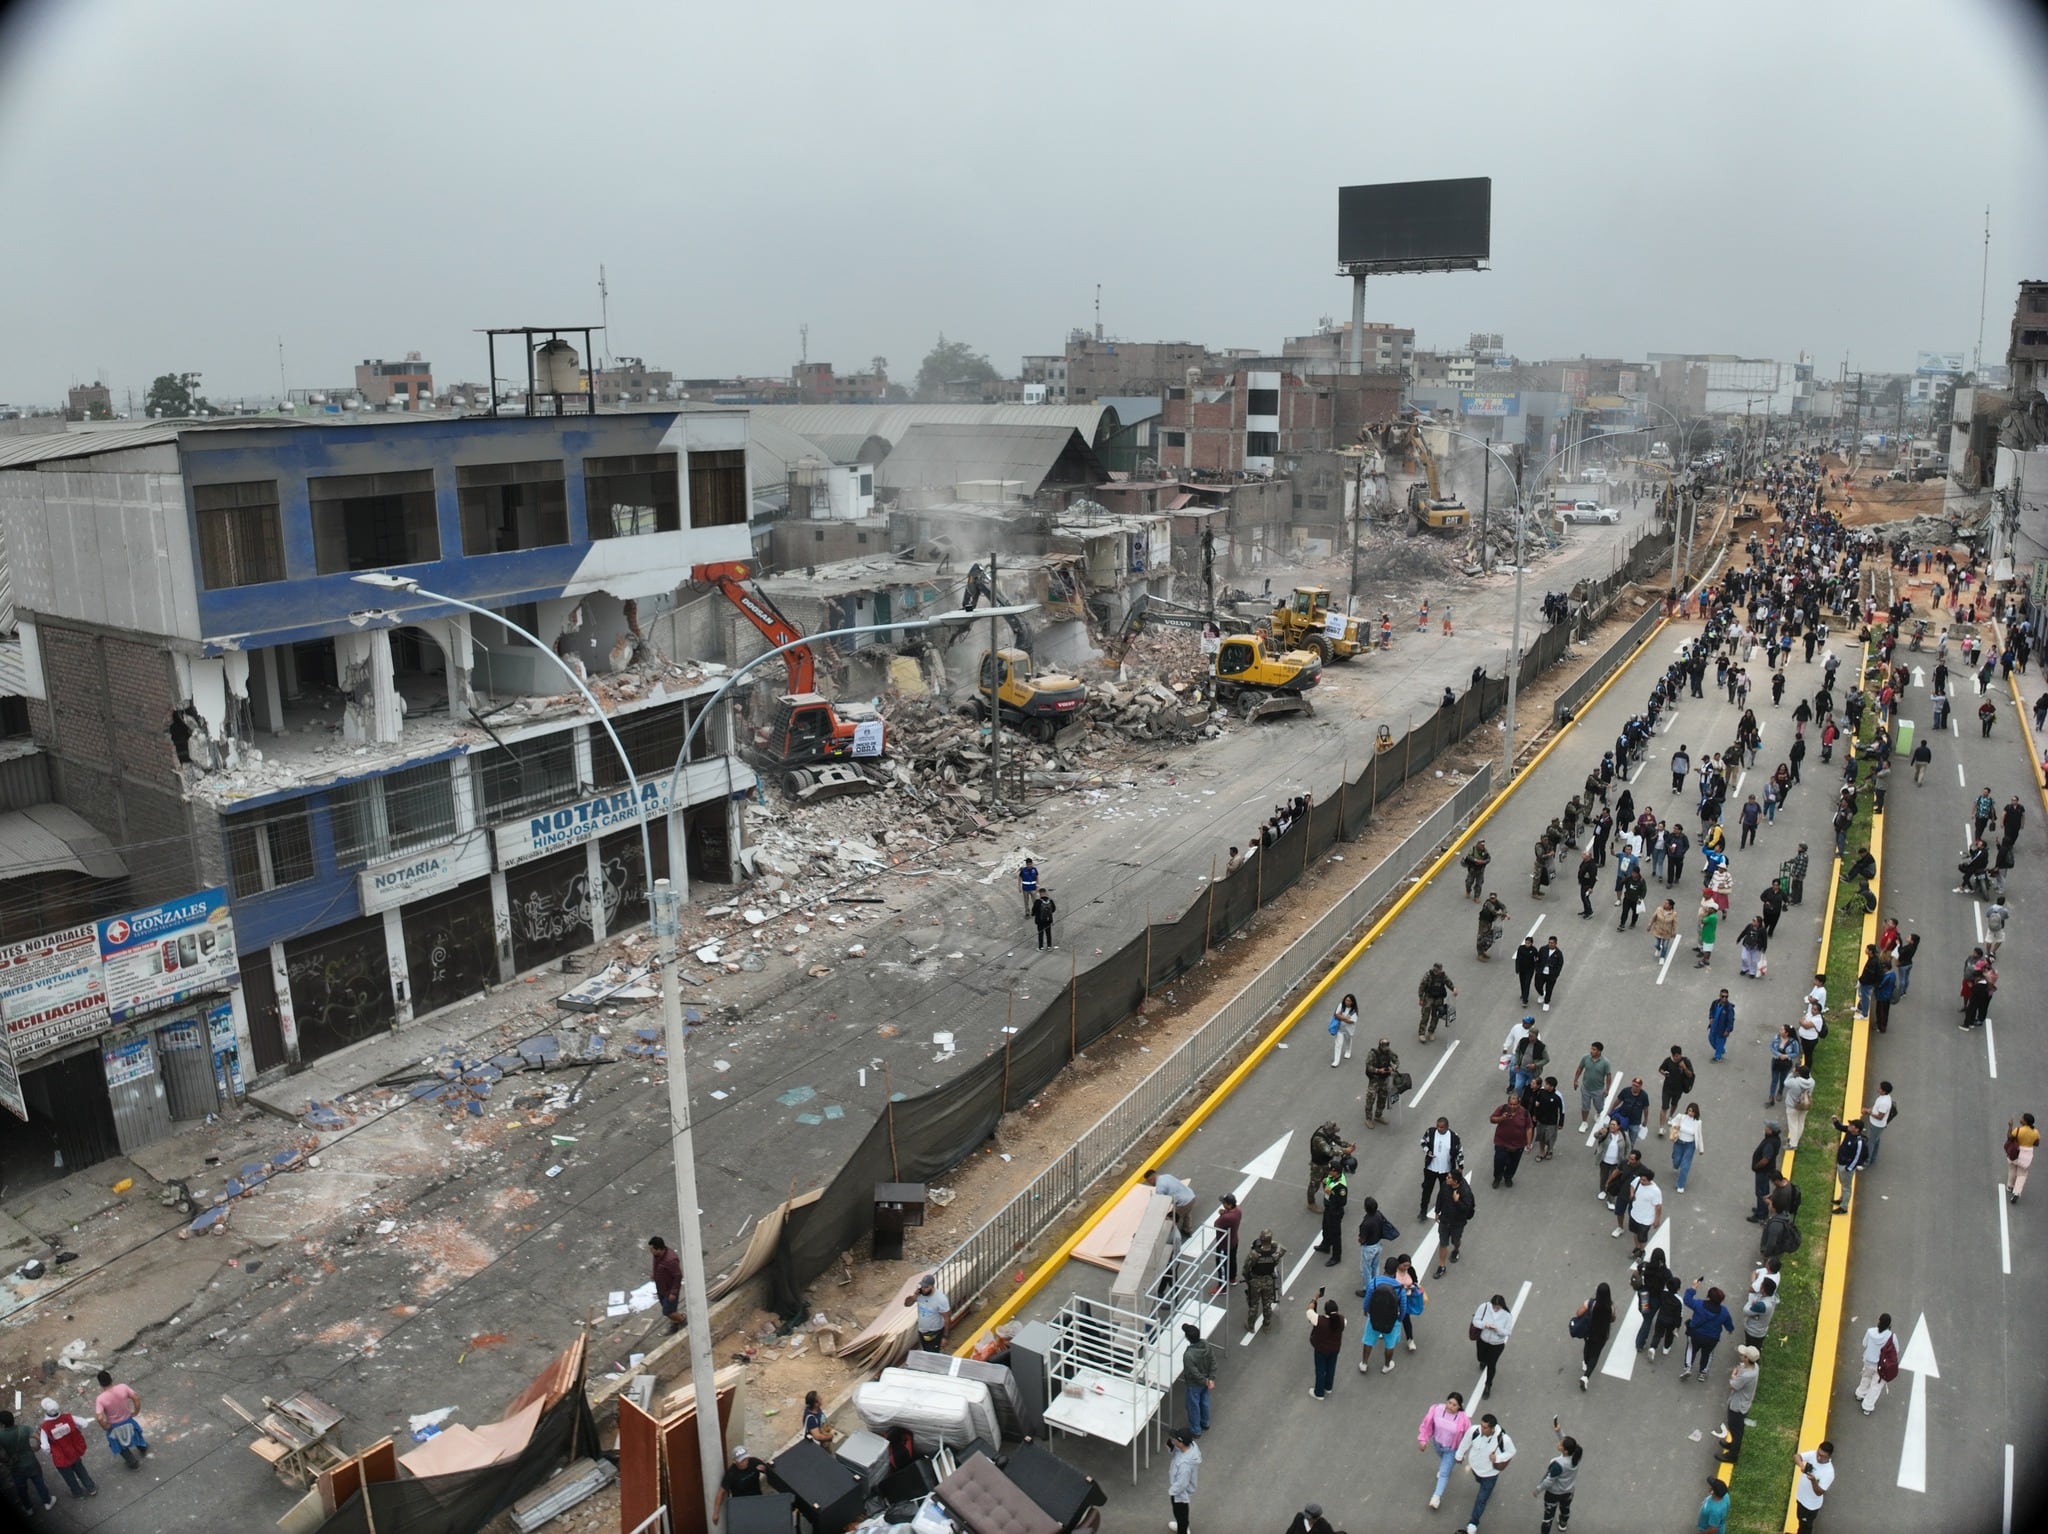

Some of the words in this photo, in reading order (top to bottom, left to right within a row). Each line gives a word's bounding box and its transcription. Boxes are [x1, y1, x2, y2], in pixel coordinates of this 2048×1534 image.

[1445, 516, 1459, 525] CAT
[741, 597, 774, 625] DOOSAN
[1164, 619, 1191, 627] VOLVO
[856, 745, 877, 753] OBRA
[533, 820, 600, 849] HINOJOSA
[602, 799, 659, 827] CARRILO
[132, 901, 207, 933] GONZALES
[26, 925, 95, 953] NOTARIALES
[35, 966, 90, 989] VIRTUALES
[7, 991, 107, 1034] NCILIACION
[45, 1007, 109, 1036] EXTRAJUDICIAL
